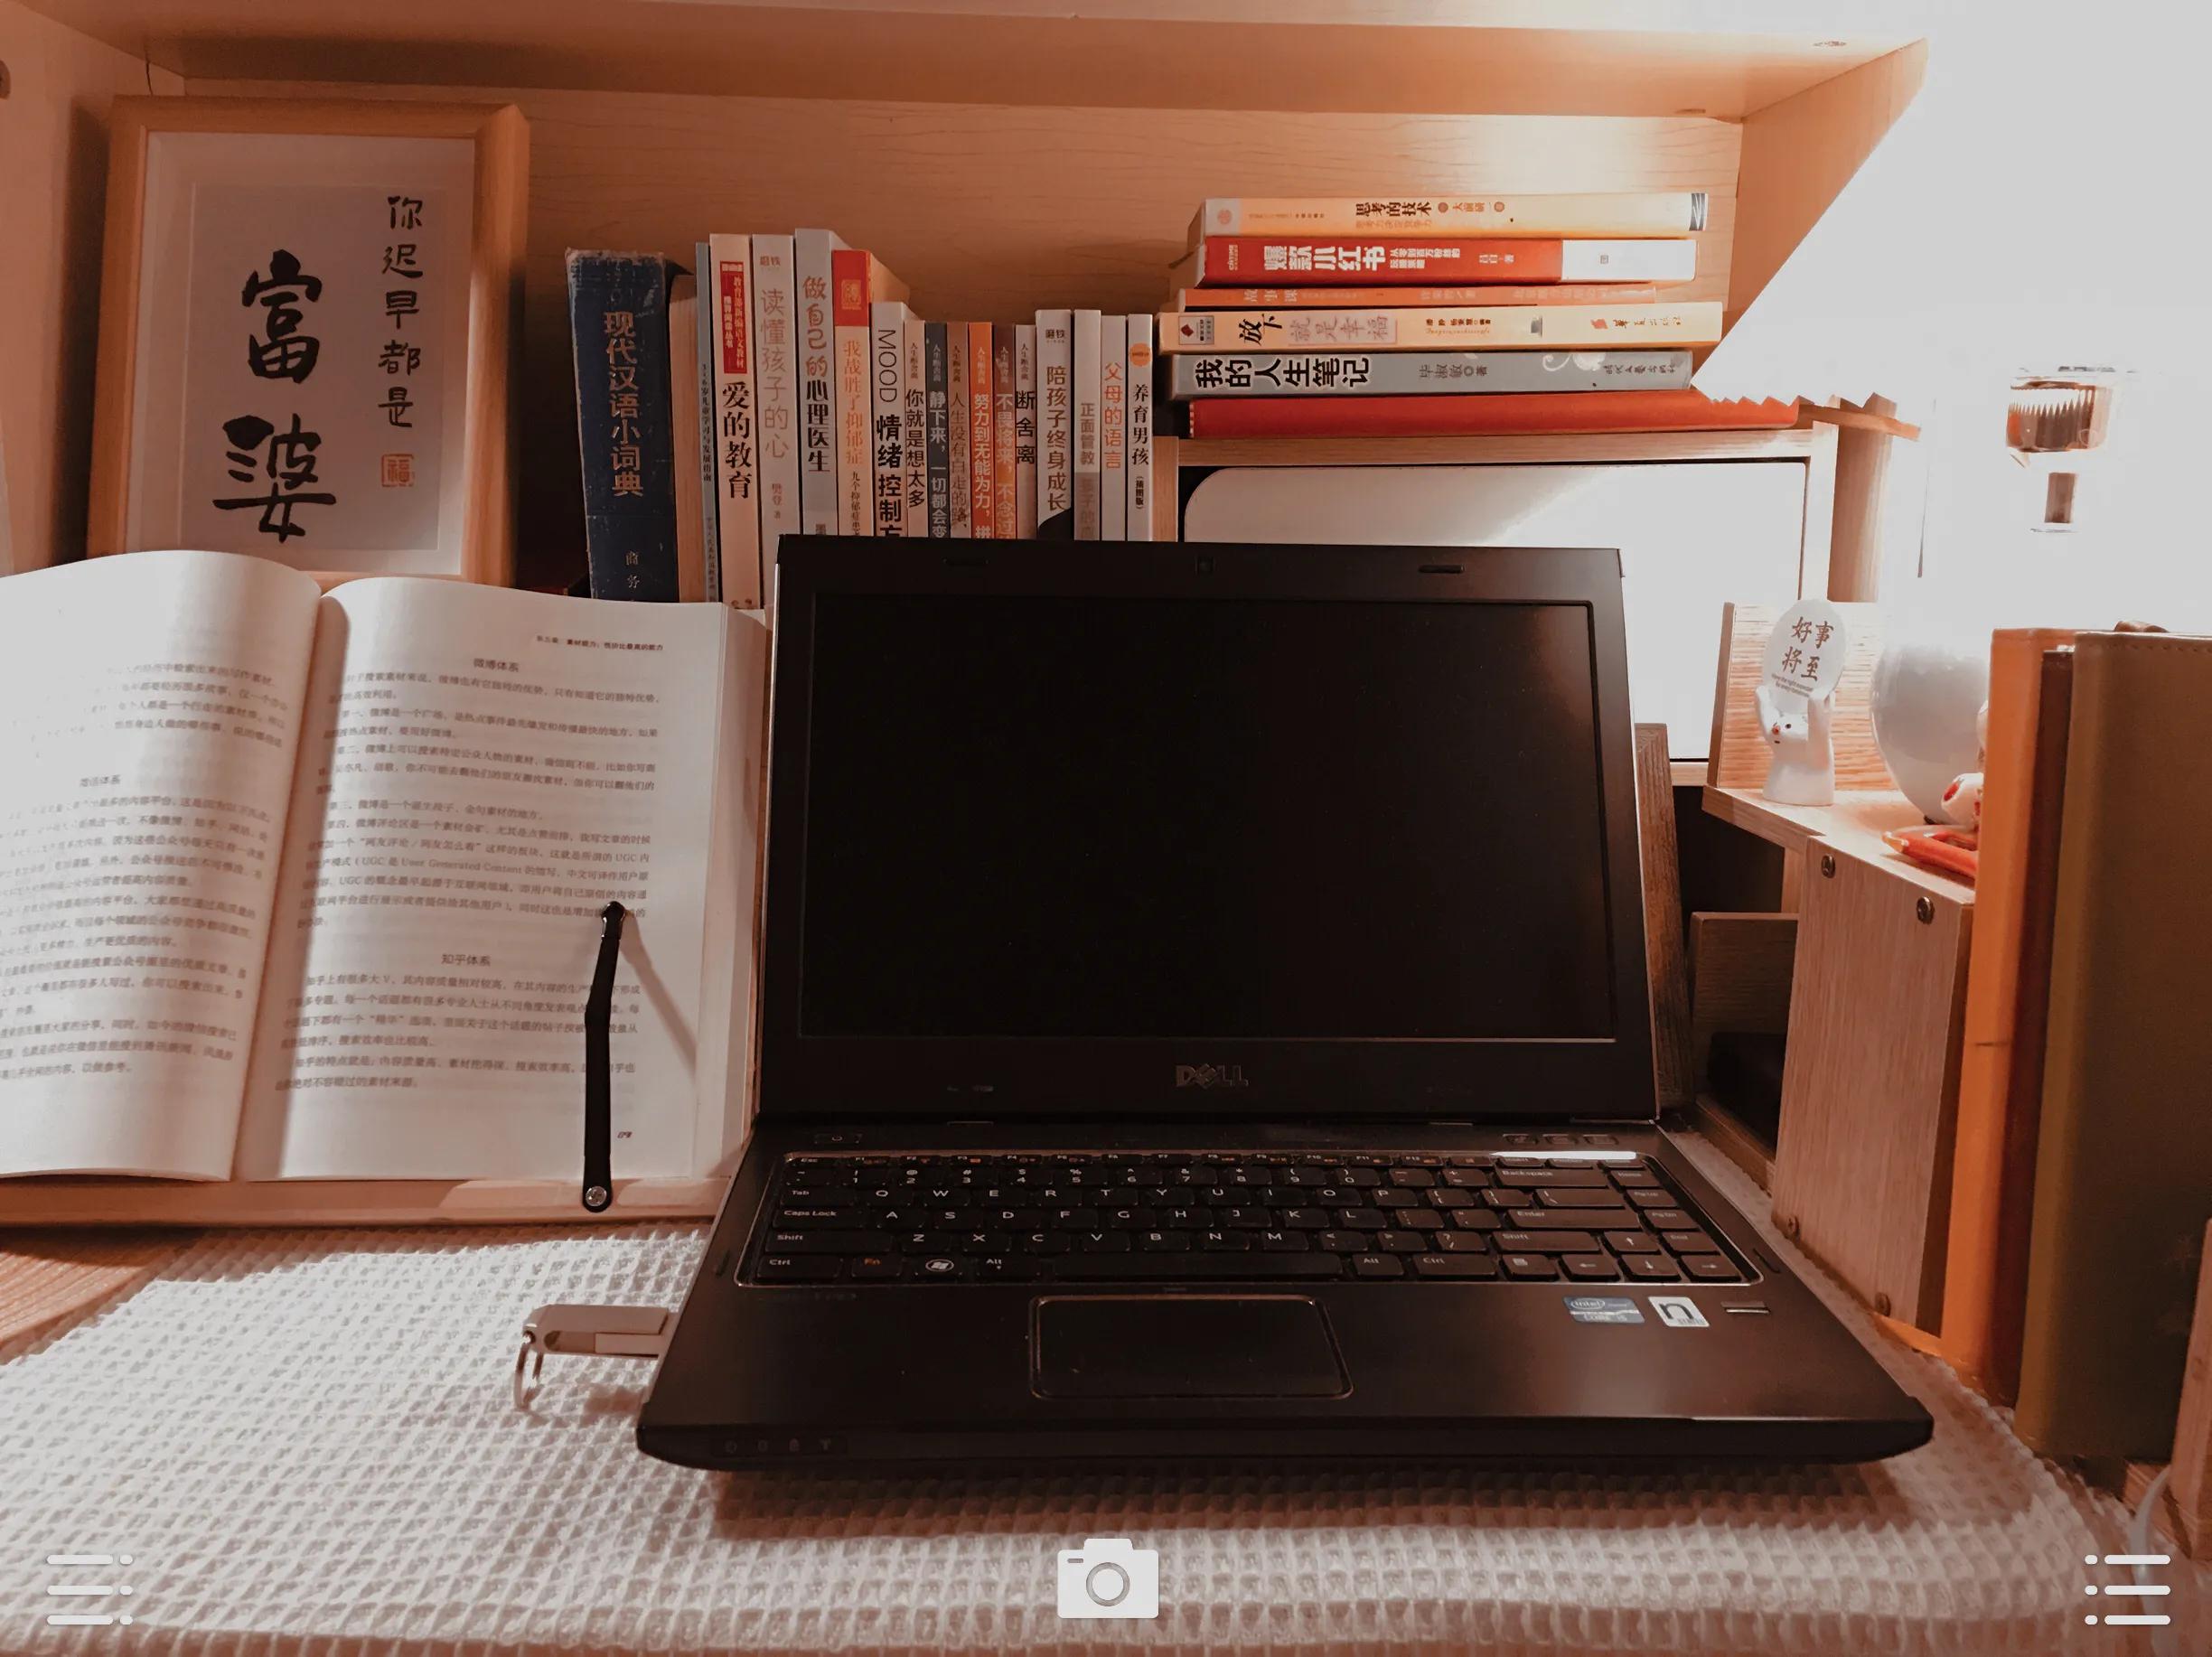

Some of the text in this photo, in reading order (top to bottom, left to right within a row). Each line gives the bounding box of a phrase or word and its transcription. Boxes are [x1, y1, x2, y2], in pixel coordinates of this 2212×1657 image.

[1355, 201, 1432, 217] 思考的技术
[1264, 245, 1386, 271] 爆款小红书
[378, 195, 424, 428] 你迟早都是
[1239, 314, 1283, 346] 放下
[1289, 315, 1390, 342] 就是幸福
[211, 249, 337, 543] 富婆
[603, 311, 644, 497] 现代汉语小词典
[761, 288, 789, 460] 读懂孩子的心
[802, 275, 831, 473] 做自己的心理医生
[841, 341, 865, 465] 我战胜了抑郁症
[877, 329, 898, 403] MOOD
[1195, 357, 1370, 389] 我的人生笔记
[723, 380, 752, 499] 爱的教育
[905, 389, 925, 508] 你就是想太多
[1017, 390, 1036, 465] 断舍离
[1046, 366, 1067, 511] 陪孩子终身成长
[1080, 403, 1095, 465] 正面管教
[1104, 361, 1123, 470] 父母的语言
[1131, 384, 1149, 466] 养育男孩
[1782, 646, 1821, 681] 将至
[1791, 616, 1834, 649] 好事
[1175, 1063, 1250, 1088] DELL
